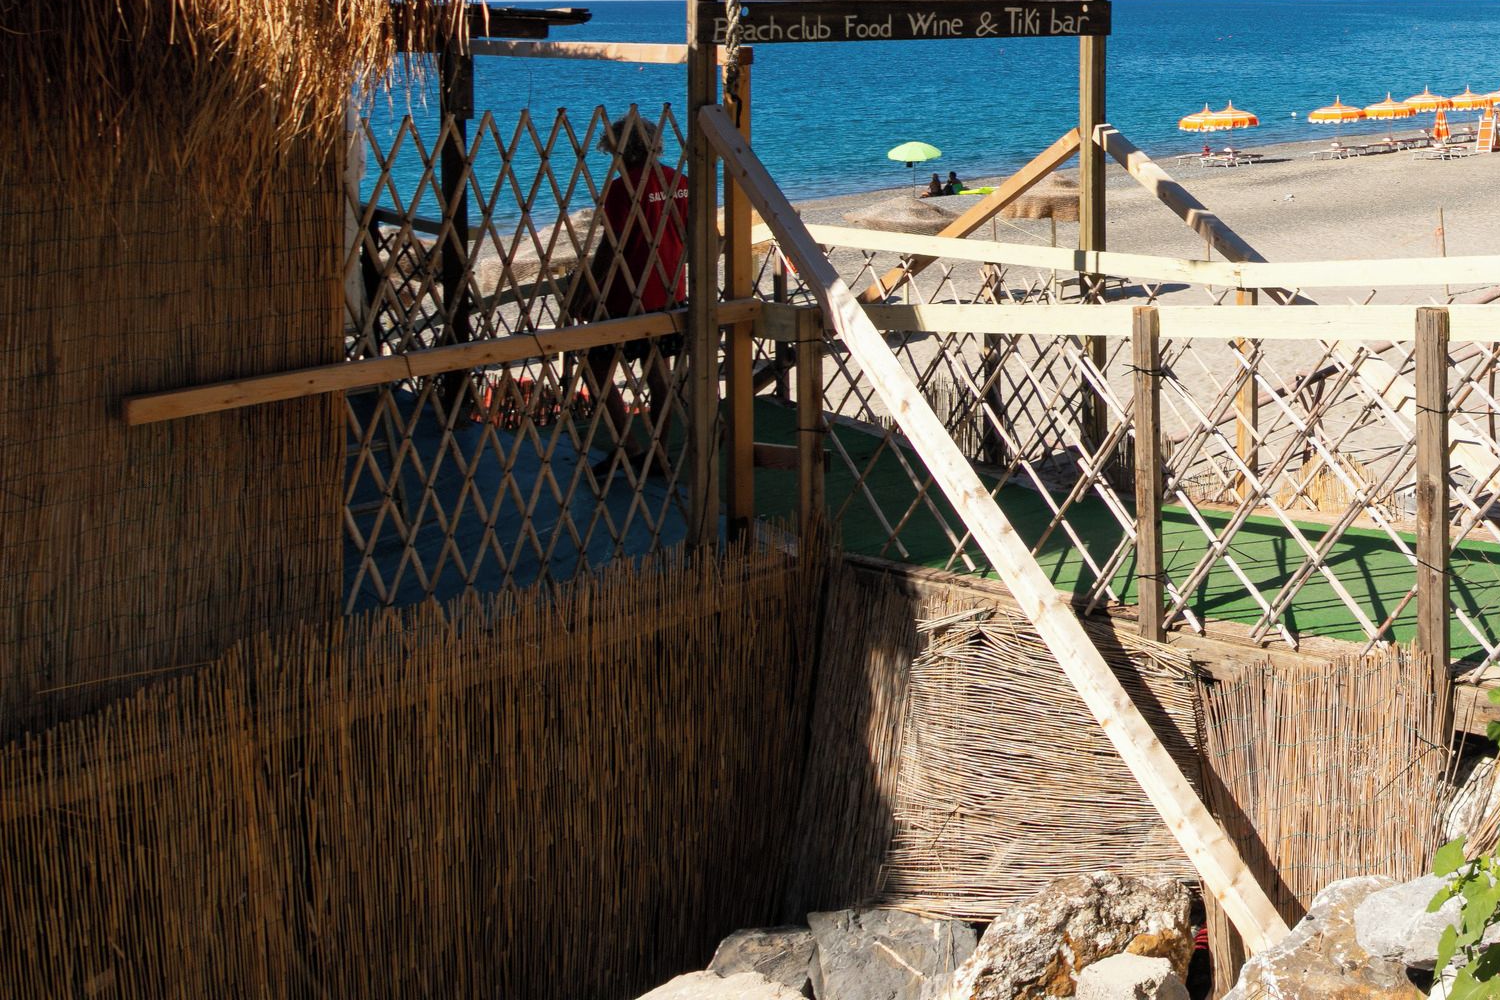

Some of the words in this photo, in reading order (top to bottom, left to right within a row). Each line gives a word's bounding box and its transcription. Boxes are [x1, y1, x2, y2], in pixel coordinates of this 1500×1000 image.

[844, 13, 892, 38] Food
[907, 11, 963, 37] Wine
[975, 11, 998, 37] &
[1050, 7, 1090, 34] bar
